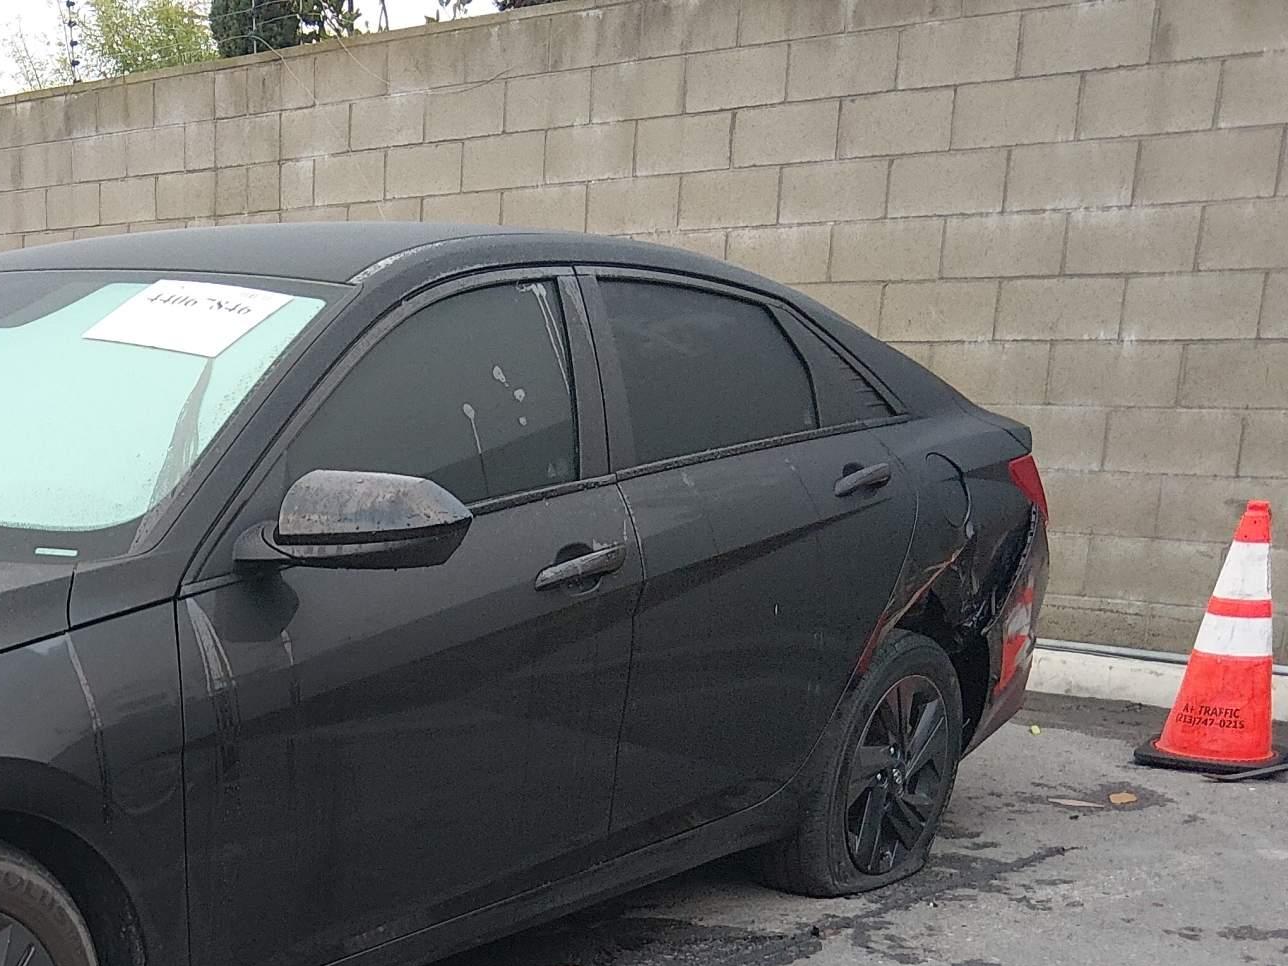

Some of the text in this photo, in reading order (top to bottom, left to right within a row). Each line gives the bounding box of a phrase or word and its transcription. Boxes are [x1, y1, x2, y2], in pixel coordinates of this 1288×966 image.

[147, 292, 252, 315] 4406 7846
[1182, 703, 1241, 719] A+ TRAFFIC
